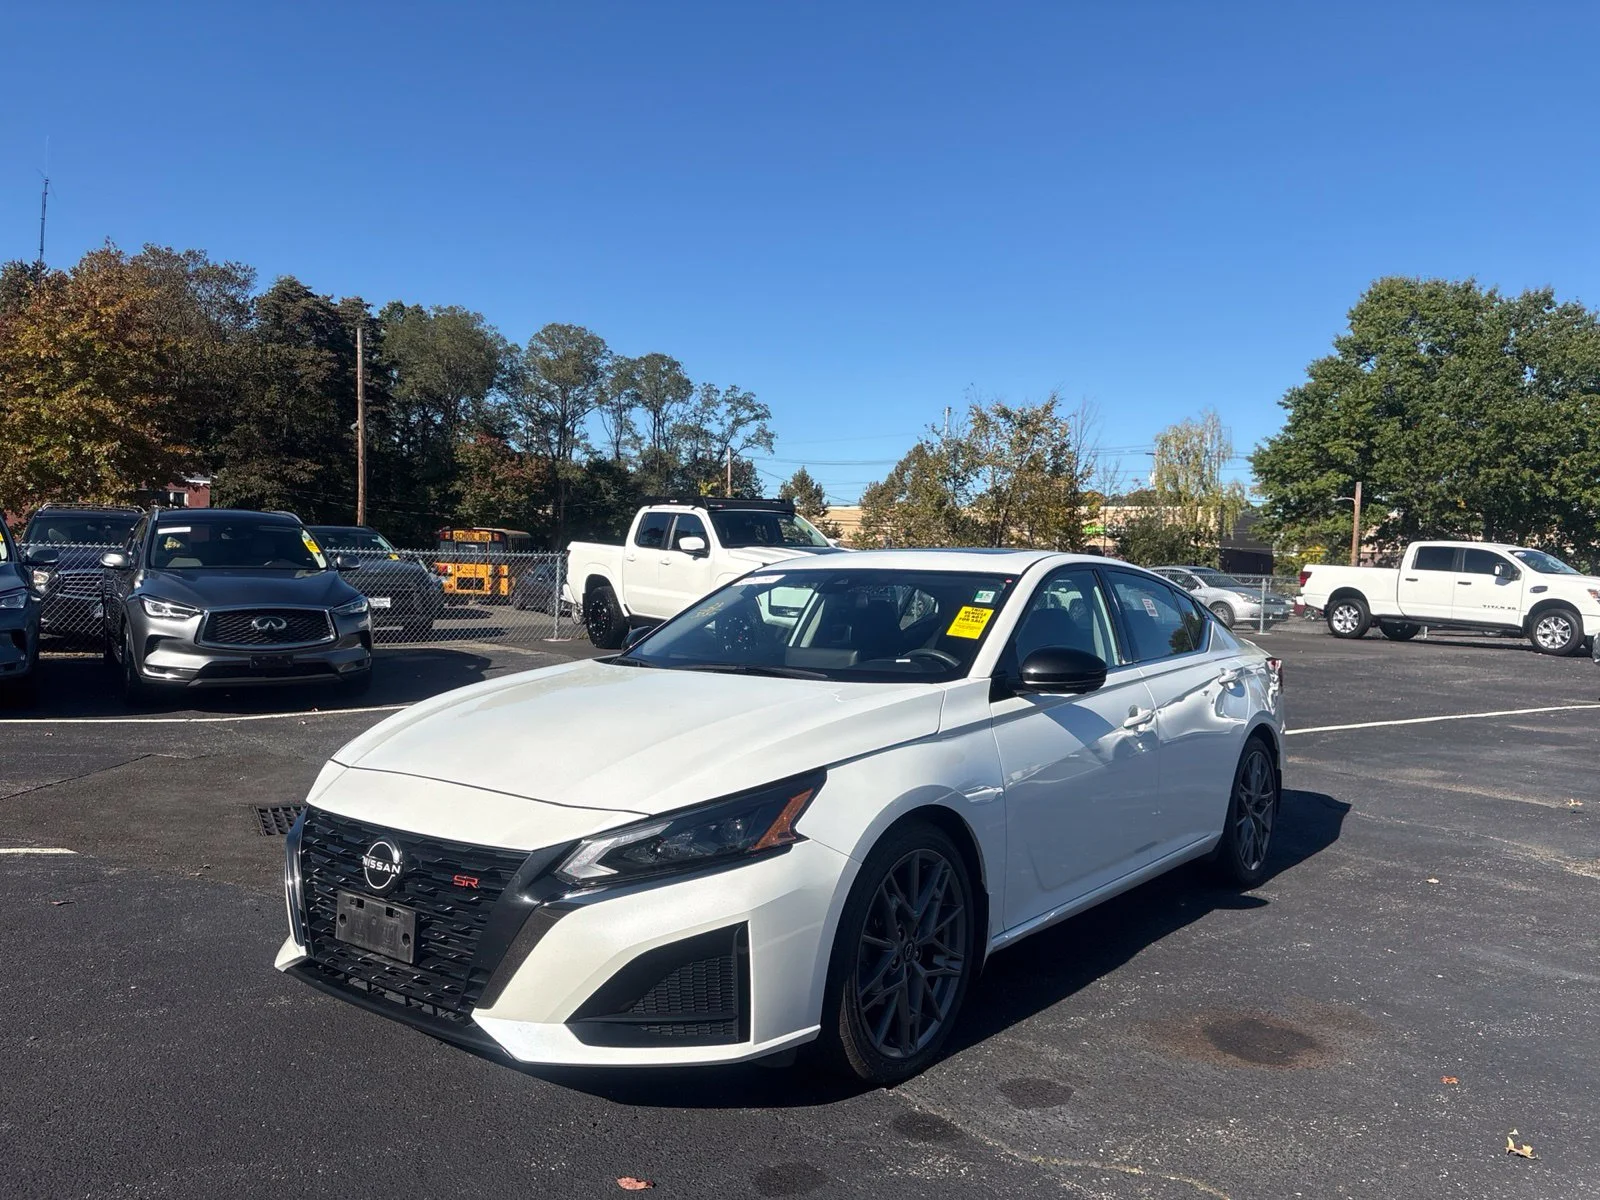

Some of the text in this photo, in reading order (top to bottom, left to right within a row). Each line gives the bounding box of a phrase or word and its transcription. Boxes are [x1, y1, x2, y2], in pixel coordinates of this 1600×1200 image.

[454, 532, 475, 540] SCHOOL
[361, 855, 401, 874] NISSAN
[453, 874, 480, 889] SR
